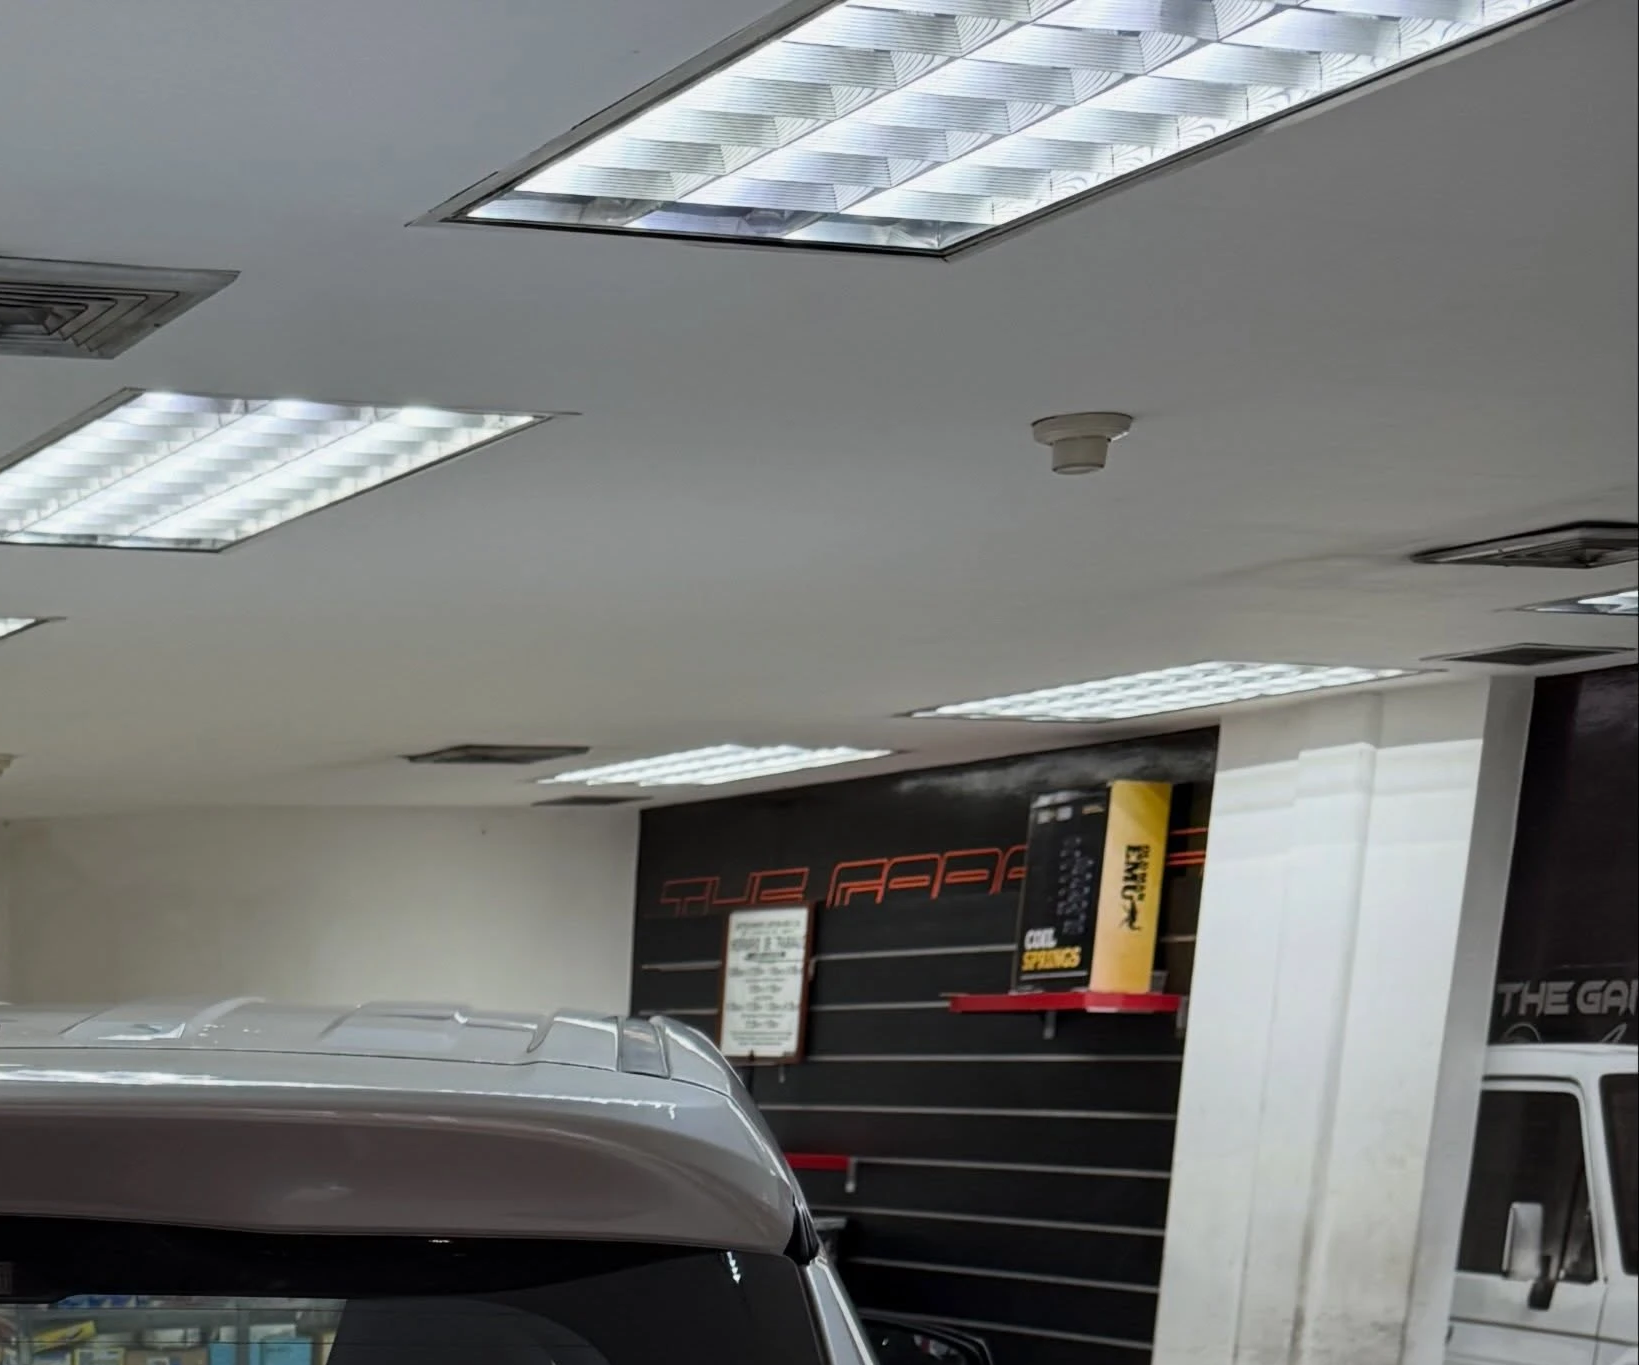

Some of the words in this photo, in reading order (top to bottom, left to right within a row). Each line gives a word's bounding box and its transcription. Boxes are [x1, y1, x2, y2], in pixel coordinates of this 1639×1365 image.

[1121, 845, 1141, 900] EMU
[1021, 946, 1082, 971] SPRINGS
[1497, 980, 1575, 1017] THE
